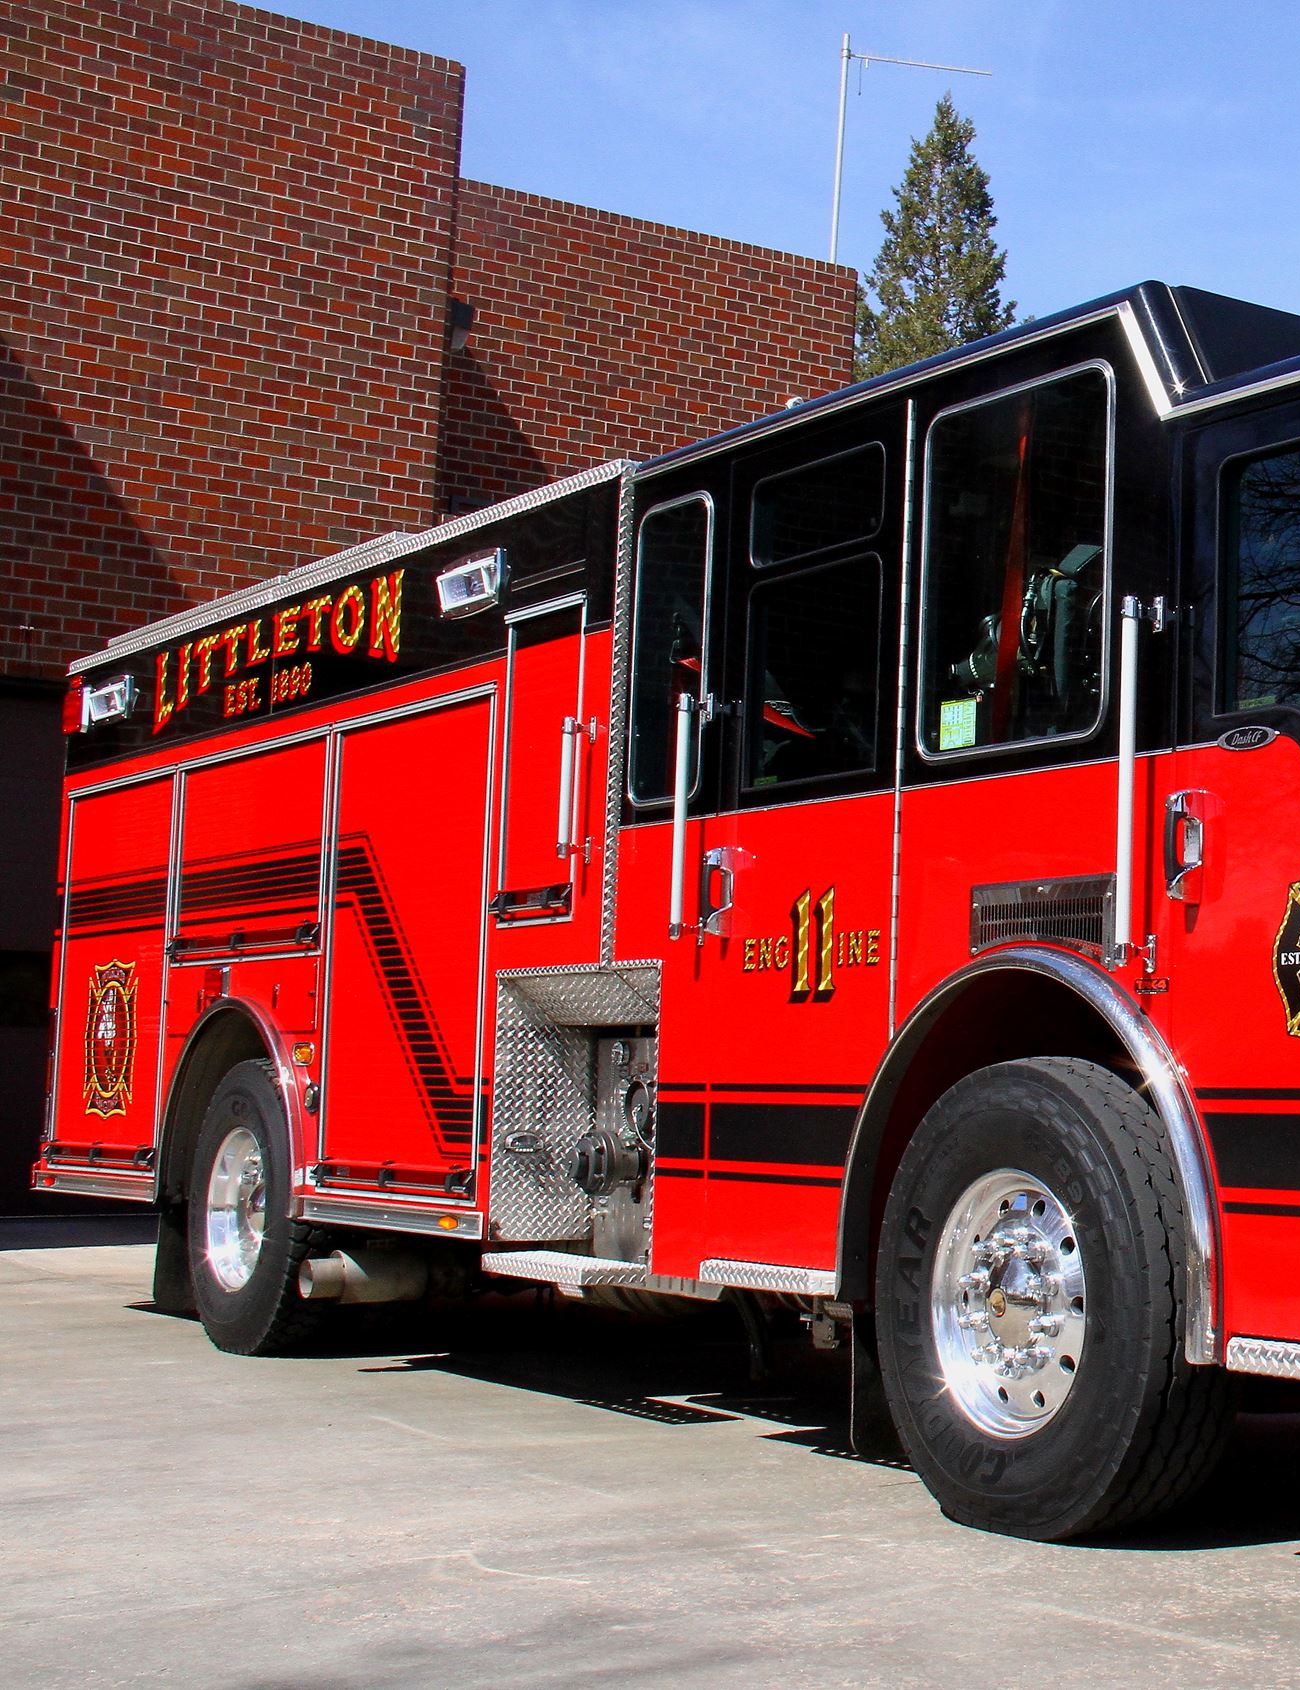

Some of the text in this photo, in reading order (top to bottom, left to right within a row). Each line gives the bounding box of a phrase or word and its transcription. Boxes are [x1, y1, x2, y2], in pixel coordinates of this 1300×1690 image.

[153, 568, 405, 735] LITTLETON
[224, 661, 313, 717] EST. 1890
[742, 883, 881, 1000] ENG 11 INE
